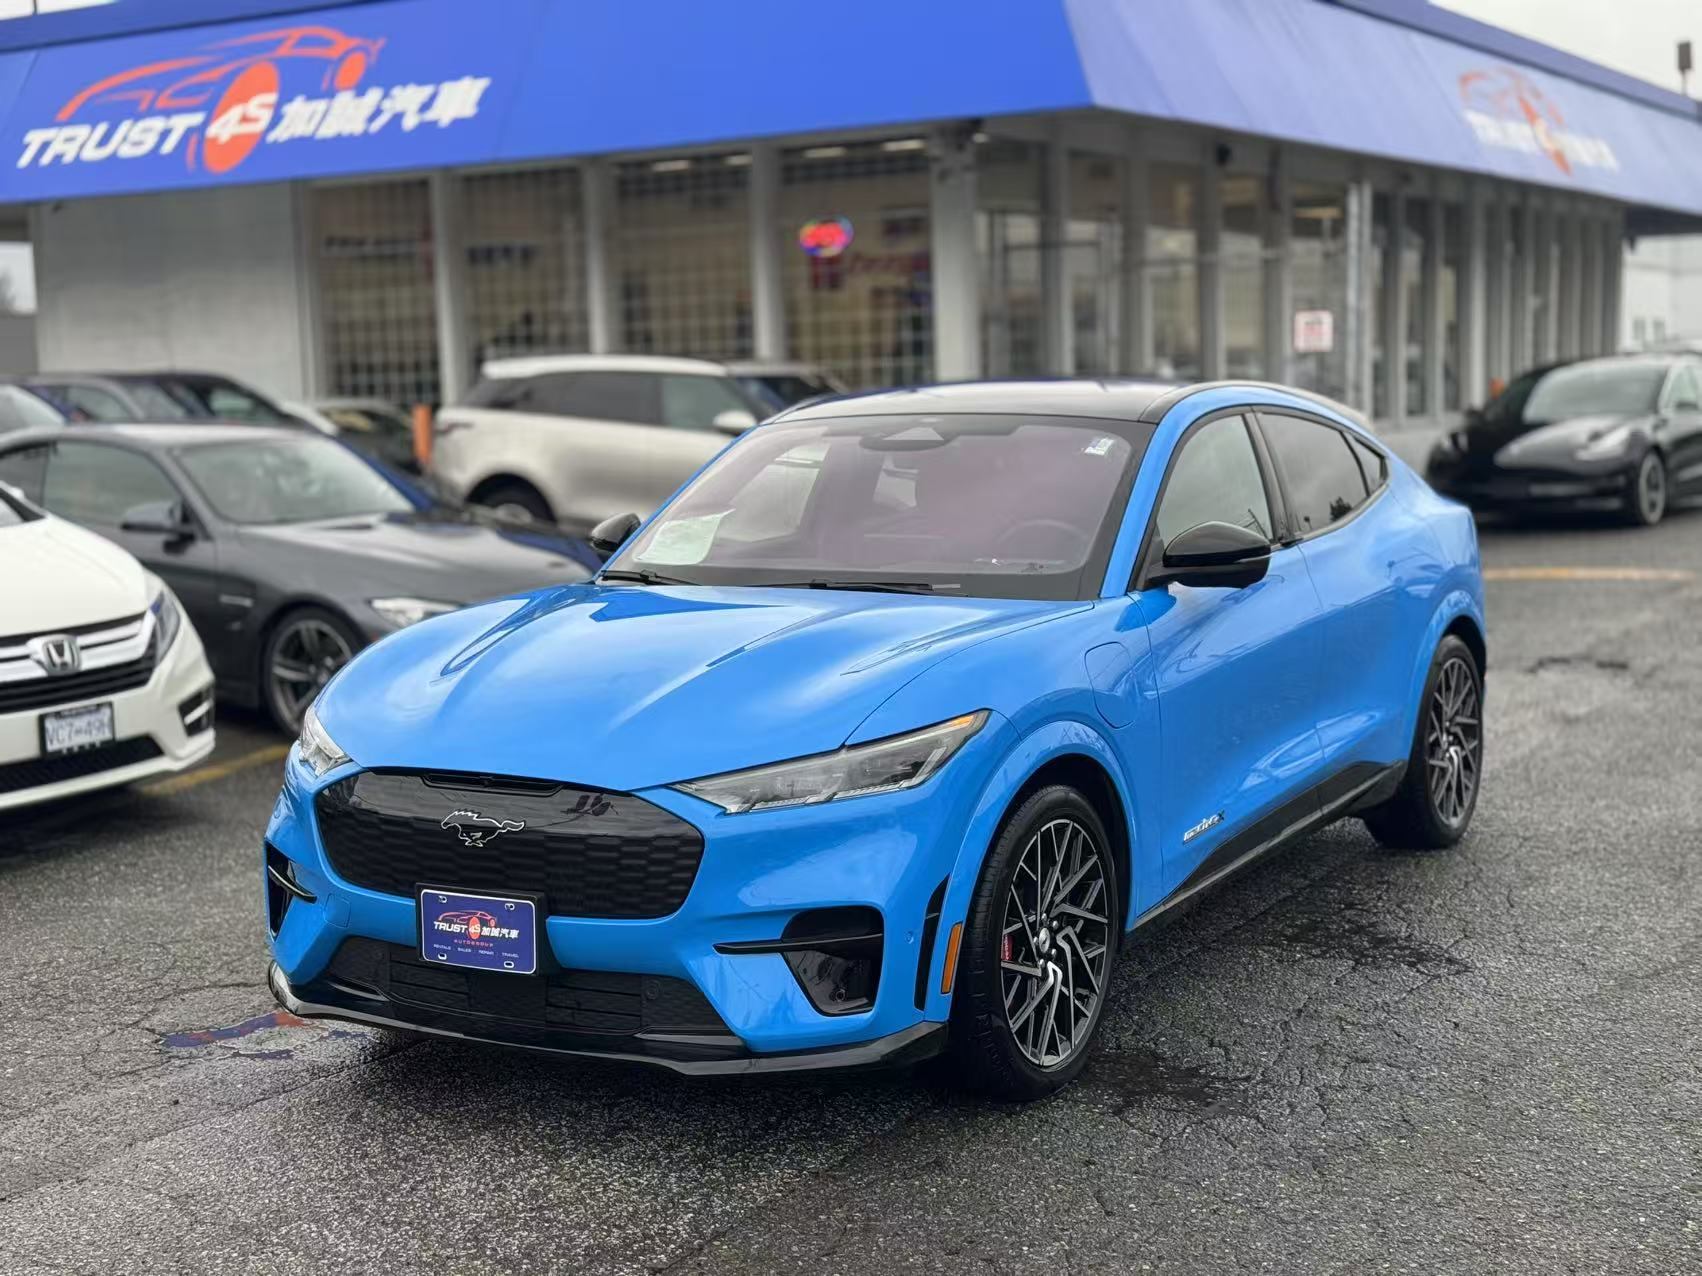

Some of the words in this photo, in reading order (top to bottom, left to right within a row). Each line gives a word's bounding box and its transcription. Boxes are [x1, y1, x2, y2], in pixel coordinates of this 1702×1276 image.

[16, 112, 205, 168] TRUST
[206, 92, 278, 145] 4S
[433, 921, 468, 933] TRUST
